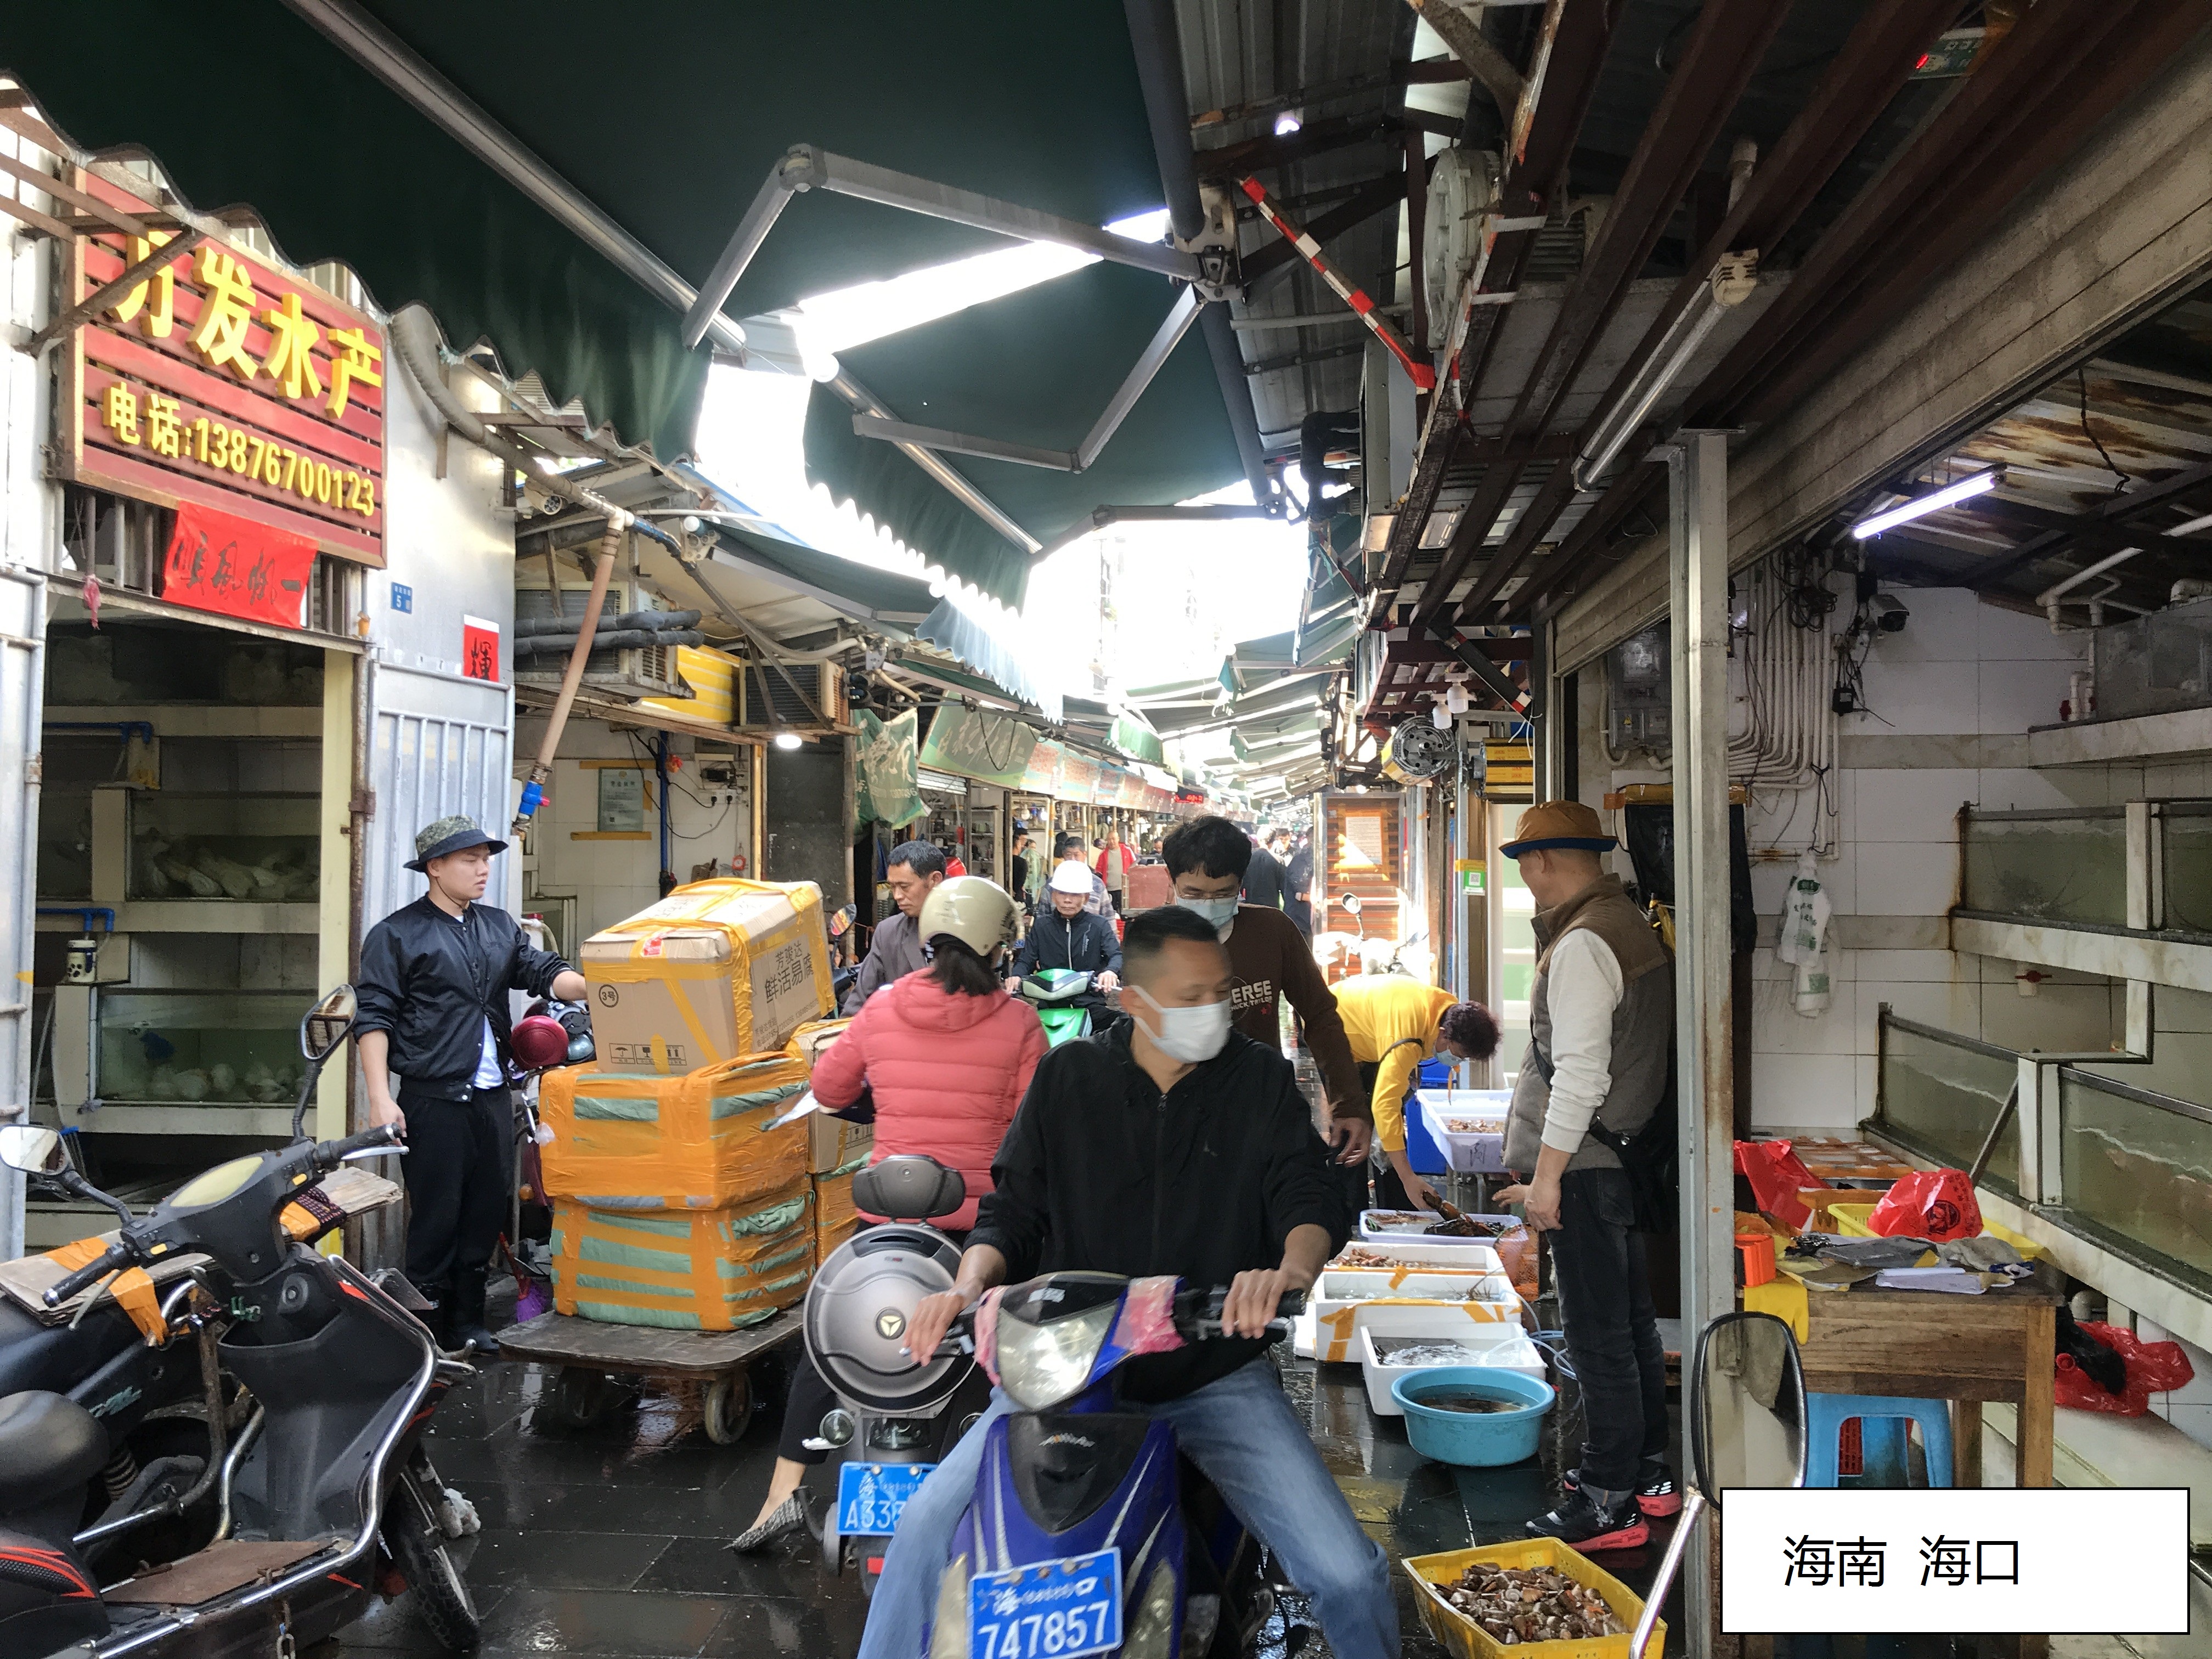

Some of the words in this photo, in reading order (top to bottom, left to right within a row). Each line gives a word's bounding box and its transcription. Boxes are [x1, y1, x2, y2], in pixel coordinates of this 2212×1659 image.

[104, 381, 375, 517] 电话:13876700123
[775, 940, 803, 970] 芳骏达
[601, 990, 616, 1002] 3号
[764, 953, 814, 1004] 鲜活易腐
[1231, 980, 1272, 1004] ERSE
[977, 1600, 1110, 1659] 747857
